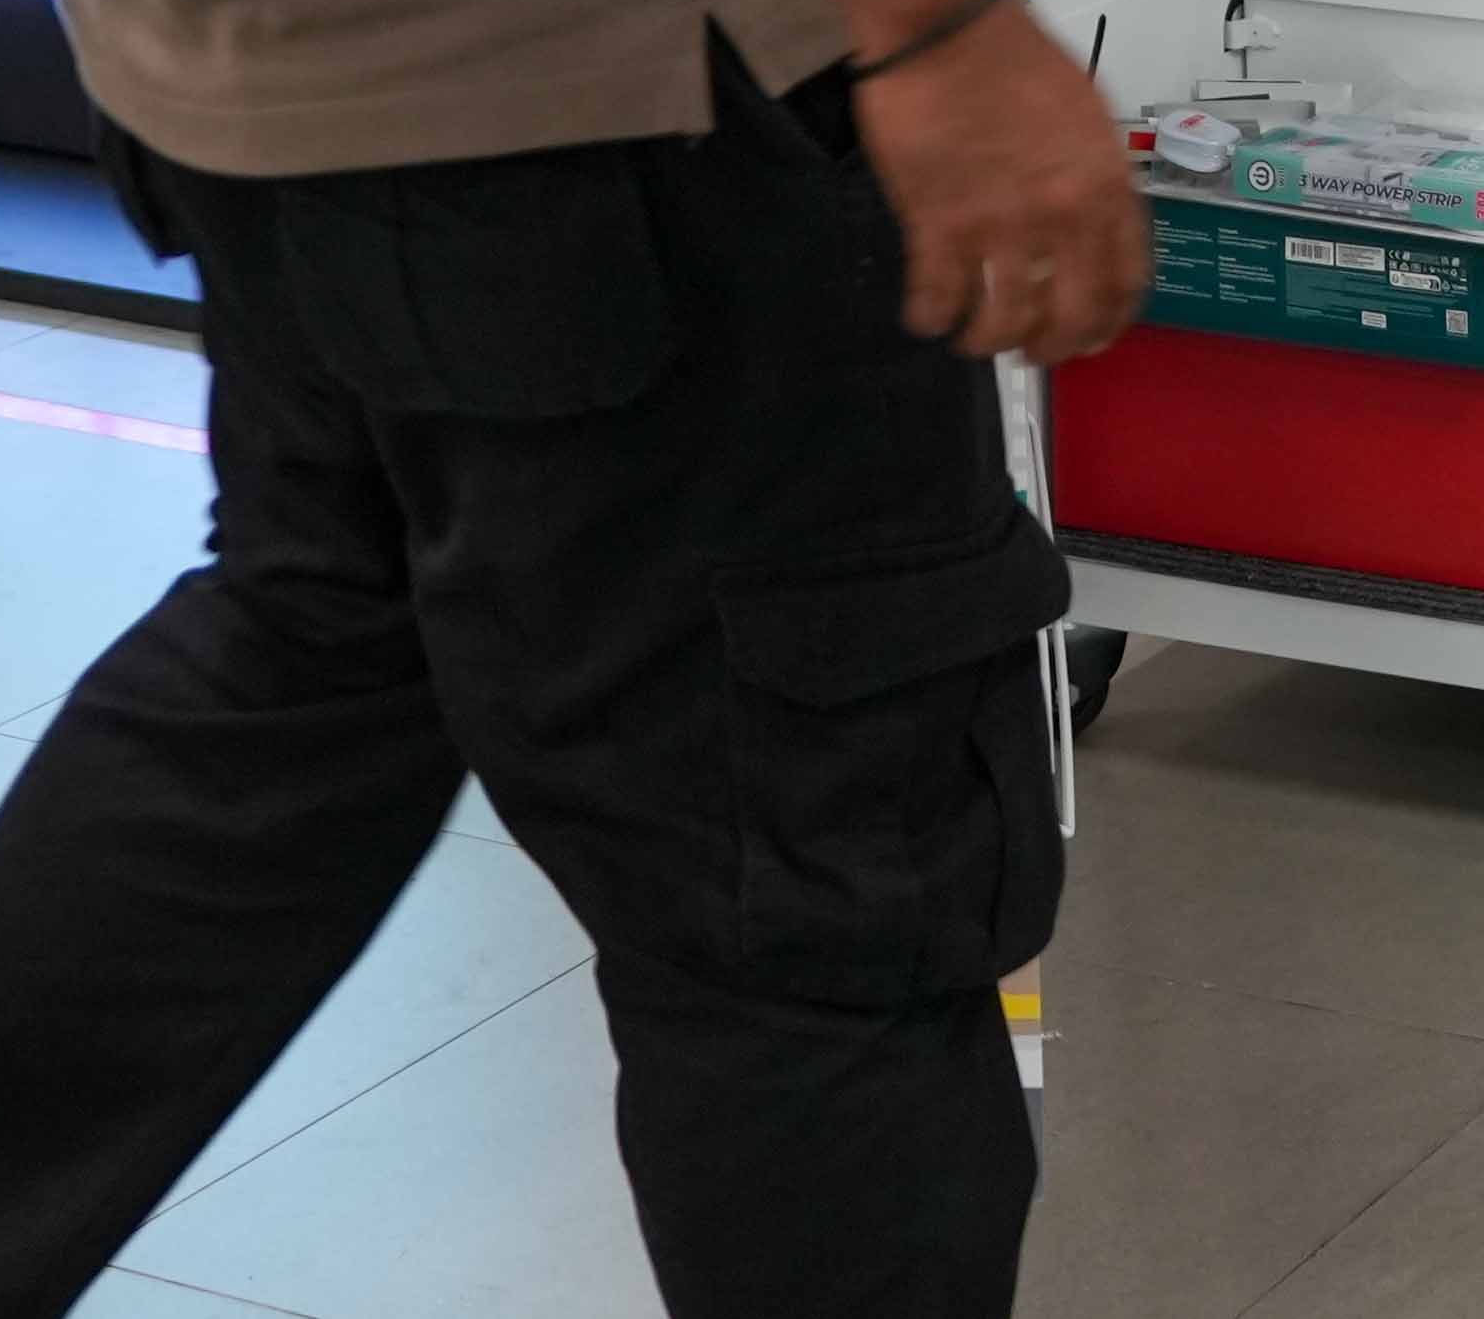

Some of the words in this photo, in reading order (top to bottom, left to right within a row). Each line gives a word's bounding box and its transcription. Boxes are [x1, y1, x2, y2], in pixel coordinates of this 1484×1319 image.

[1298, 172, 1308, 188] 3
[1312, 176, 1350, 194] WAY
[1351, 181, 1415, 203] POWER
[1417, 190, 1463, 209] STRIP
